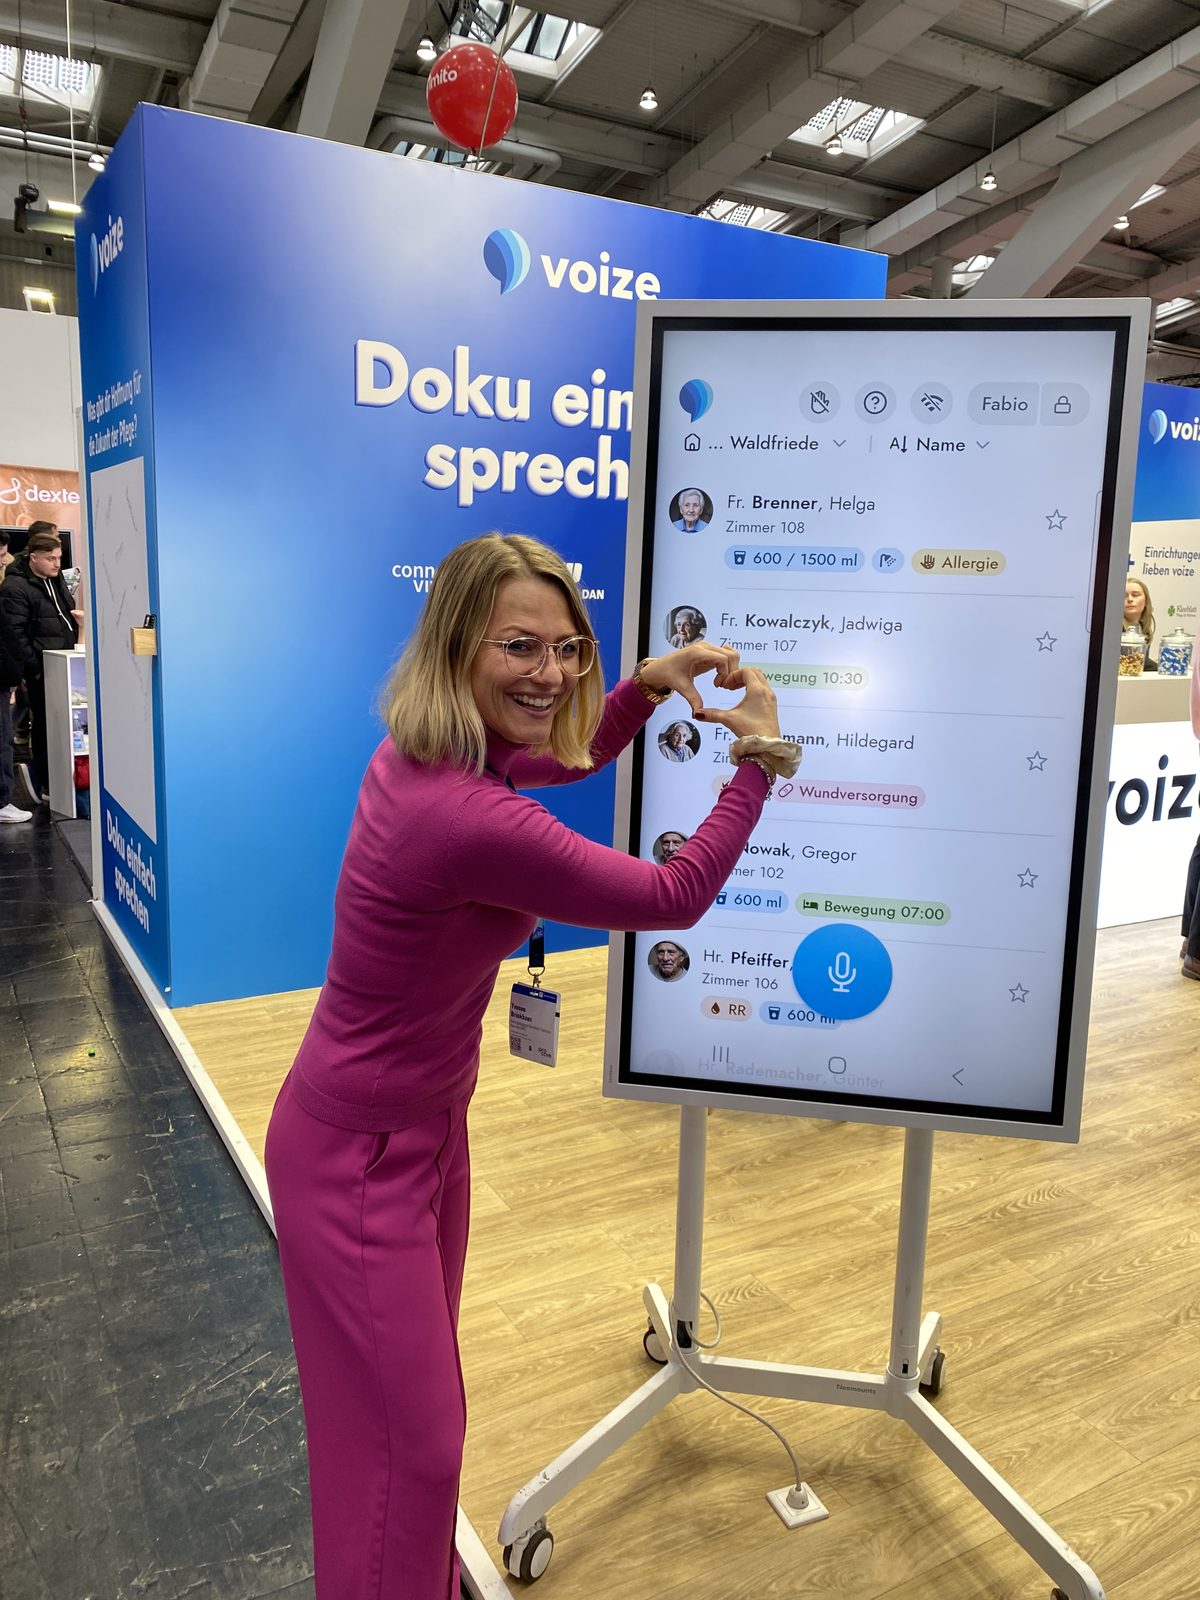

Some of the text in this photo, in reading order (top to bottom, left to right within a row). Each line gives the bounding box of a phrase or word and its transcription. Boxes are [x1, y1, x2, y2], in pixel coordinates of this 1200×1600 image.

[98, 213, 124, 273] voize
[539, 250, 662, 300] voize
[353, 338, 531, 423] Doku
[96, 394, 104, 423] gibt
[110, 380, 134, 409] Hoffnung
[133, 369, 142, 397] für
[550, 368, 634, 432] ein
[981, 396, 1029, 412] Fabio
[88, 413, 138, 457] die Zukunft der Pflege?
[1170, 416, 1200, 442] voi
[730, 434, 819, 452] Waldfriede
[916, 437, 966, 452] Name
[421, 434, 631, 508] sprech
[727, 494, 876, 514] Fr. Brenner, Helga
[725, 520, 805, 534] Zimmer 108
[753, 552, 858, 568] 600 / 1500 ml
[941, 555, 999, 571] Allergie
[1144, 546, 1200, 563] Einrichtunge
[1142, 562, 1170, 576] lieben
[1172, 565, 1195, 577] voize
[720, 612, 903, 635] Fr. Kowalczyk, Jadwiga
[719, 637, 798, 652] Zimmer 107
[822, 672, 863, 685] 10:30
[714, 727, 732, 741] Fr.
[836, 733, 915, 751] Hildegard
[800, 786, 918, 806] Wundversorgung
[1108, 754, 1200, 826] oiz
[106, 808, 157, 902] Doku einfach
[802, 845, 857, 864] Gregor
[760, 866, 784, 879] 102
[114, 866, 150, 935] sprechen
[734, 894, 782, 909] 600 ml
[824, 900, 945, 920] Bewegung 07:00
[703, 950, 793, 972] Hr. Pfeiffer,
[702, 972, 778, 990] Zimmer 106
[728, 1004, 746, 1016] RR
[787, 1009, 815, 1022] 600
[698, 1058, 886, 1089] Hr. Rademacher, Günter
[836, 1384, 877, 1394] Neomounts
